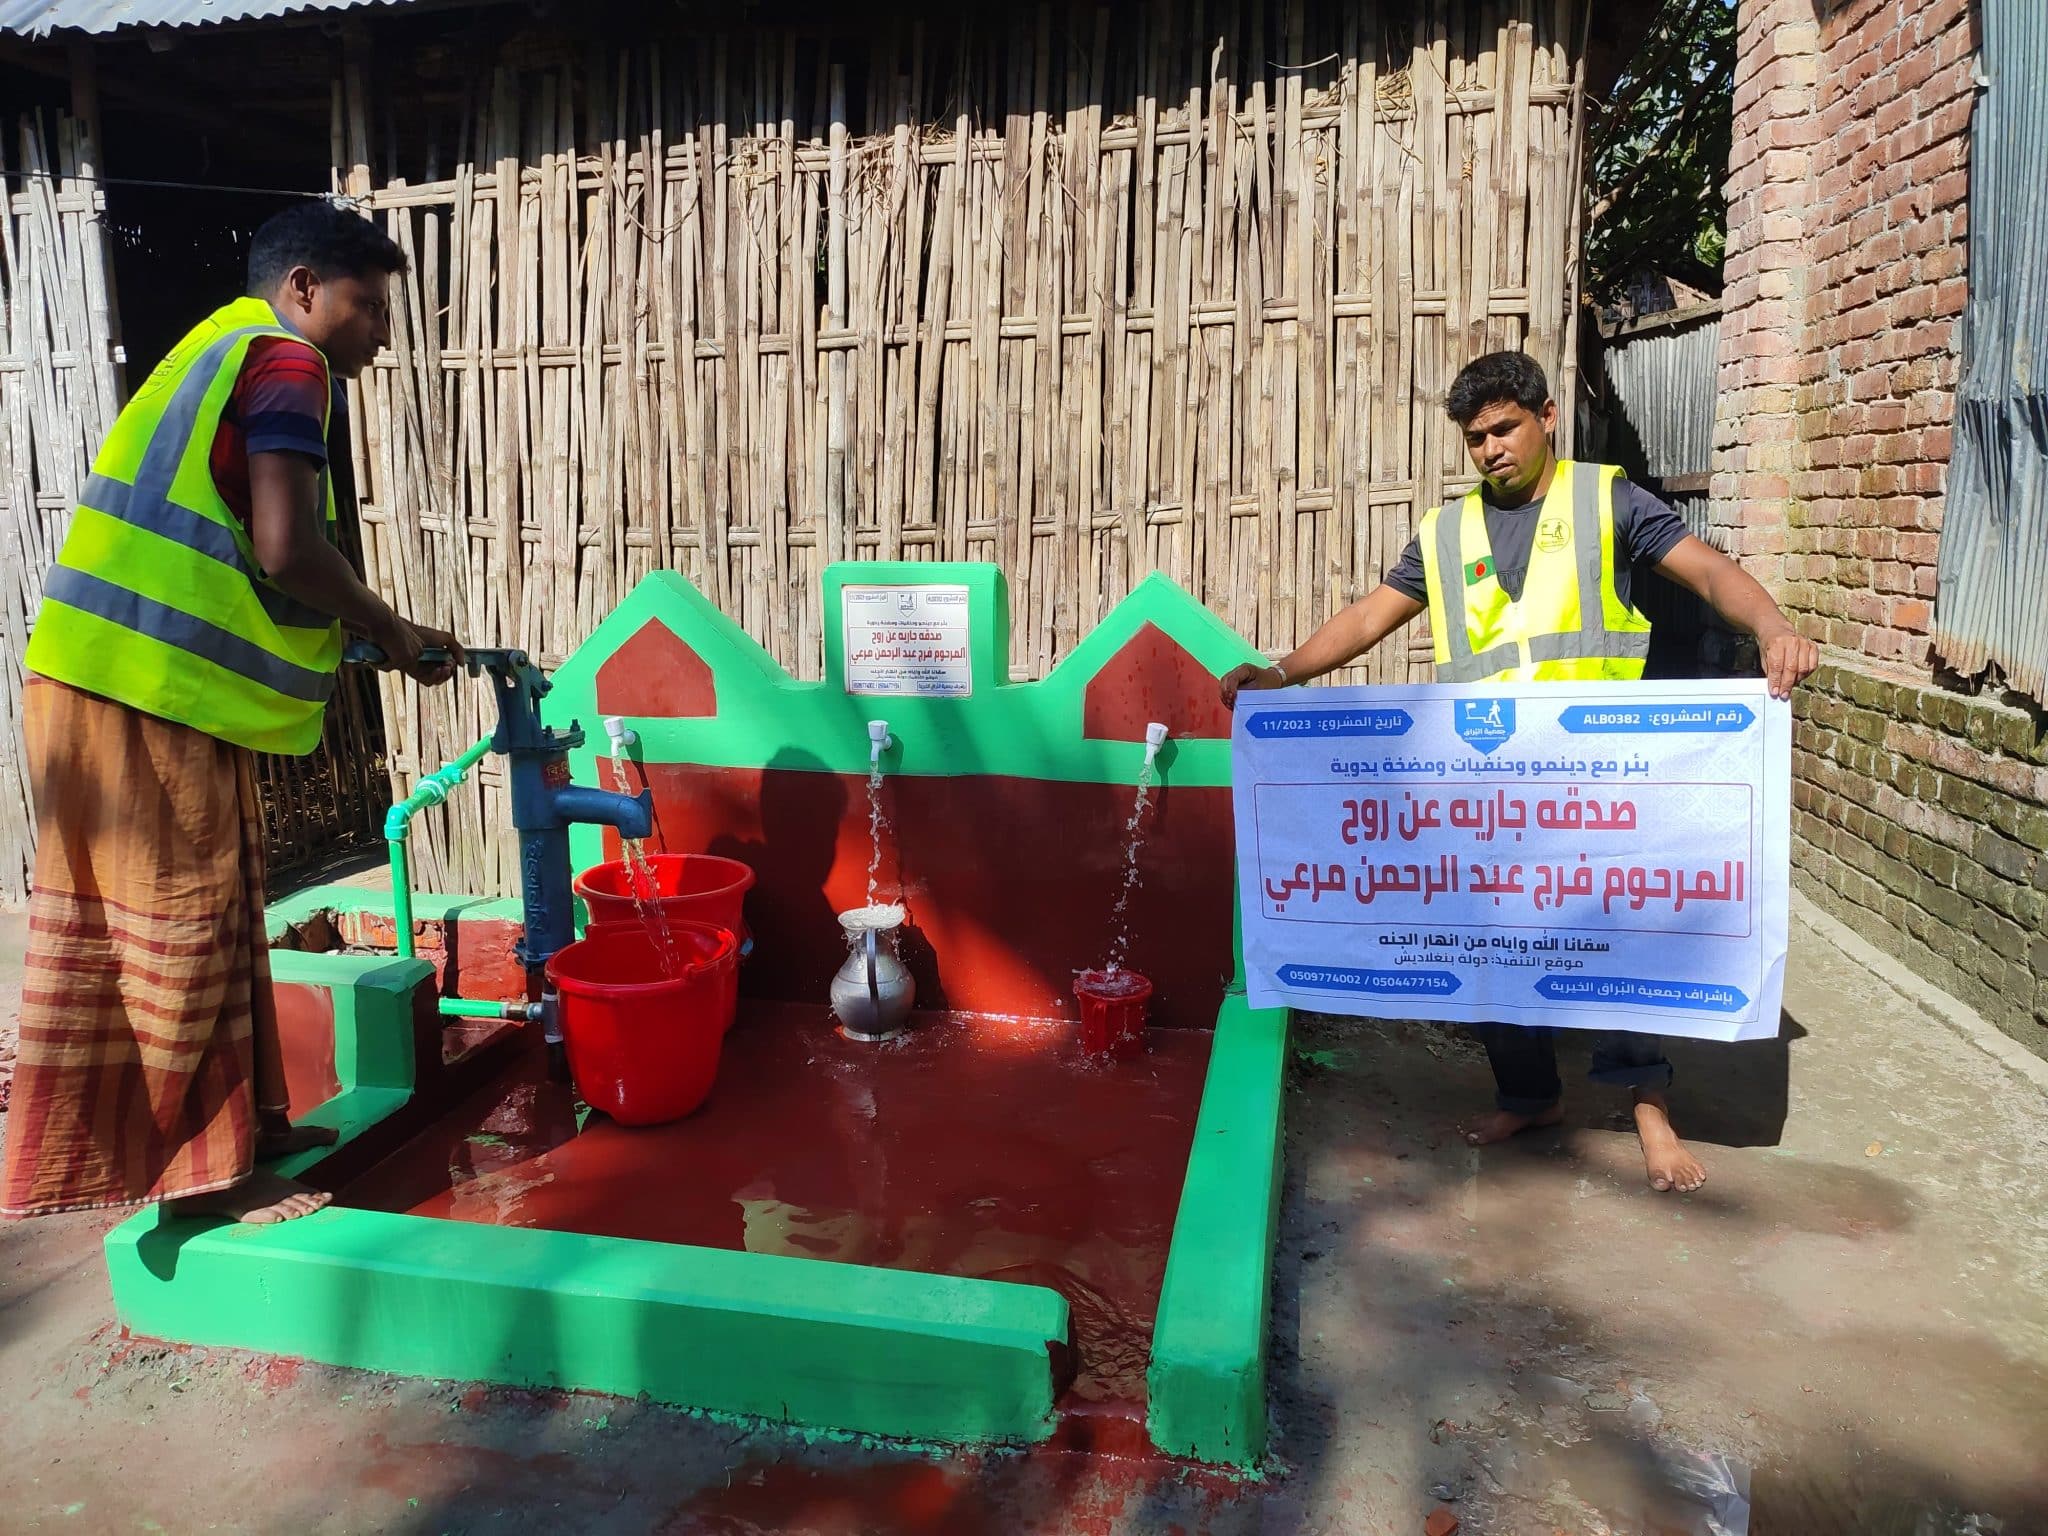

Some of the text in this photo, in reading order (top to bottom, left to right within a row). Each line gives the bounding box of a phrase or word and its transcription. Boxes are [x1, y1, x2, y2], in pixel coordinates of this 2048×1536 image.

[1262, 715, 1402, 732] تاريخ المشروع: 11/2023
[1715, 711, 1743, 726] رقم
[1330, 752, 1649, 777] بئر مع دينمو وحنفيات ومضخة يدوية
[1341, 786, 1637, 845] صدقه جاريه عن روح
[1265, 853, 1744, 915] المرحوم فرج عبد الرحمن مرعي
[1378, 930, 1610, 953] سقانا الله واياه من انهار الجنه
[1394, 951, 1584, 971] موقع التنفيذ: دولة بنغلاديش
[1289, 970, 1361, 985] 0509774002
[1372, 975, 1449, 988] 0504477154
[1550, 980, 1594, 995] الخيرية
[1637, 984, 1682, 1001] جمعية
[1684, 988, 1733, 1006] بإشراف
